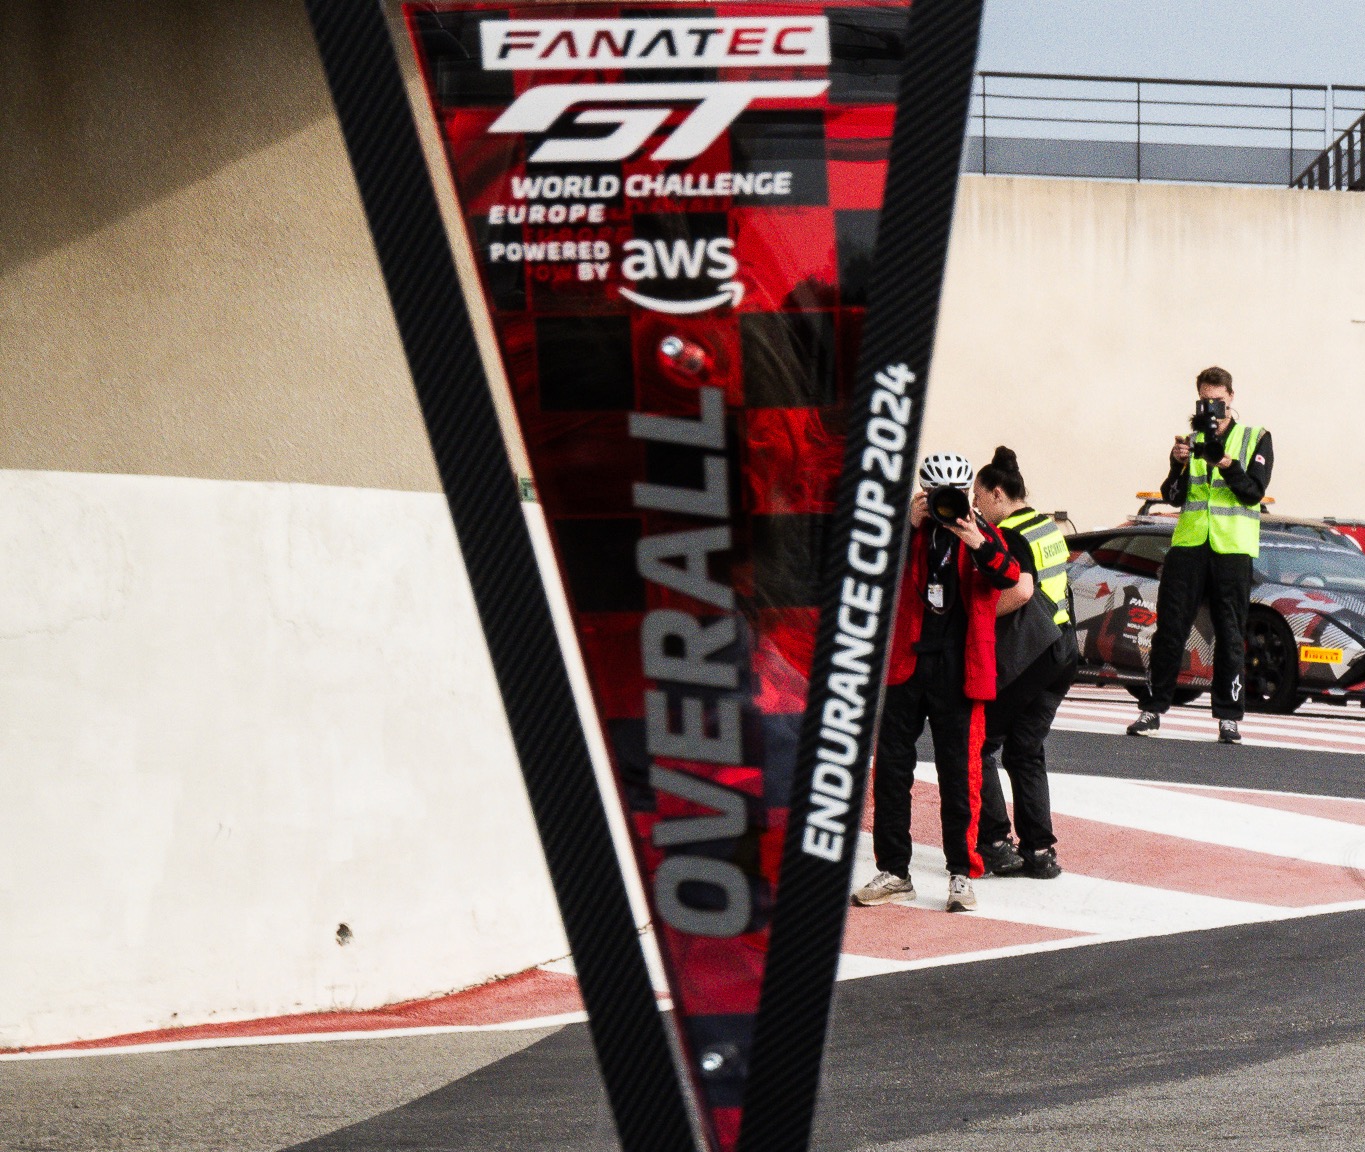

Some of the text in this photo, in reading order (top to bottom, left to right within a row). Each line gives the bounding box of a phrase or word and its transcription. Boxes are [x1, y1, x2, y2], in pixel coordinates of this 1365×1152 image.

[498, 26, 812, 59] FANATEC
[487, 79, 832, 163] GT
[511, 171, 794, 200] WORLD CHALLENGE
[488, 204, 605, 226] EUROPE
[489, 236, 738, 281] POWERED aws
[577, 262, 610, 282] BY
[802, 362, 916, 862] ENDURANCE CUP 2024
[628, 387, 751, 938] OVERALL
[1303, 649, 1339, 662] PIRELLI
